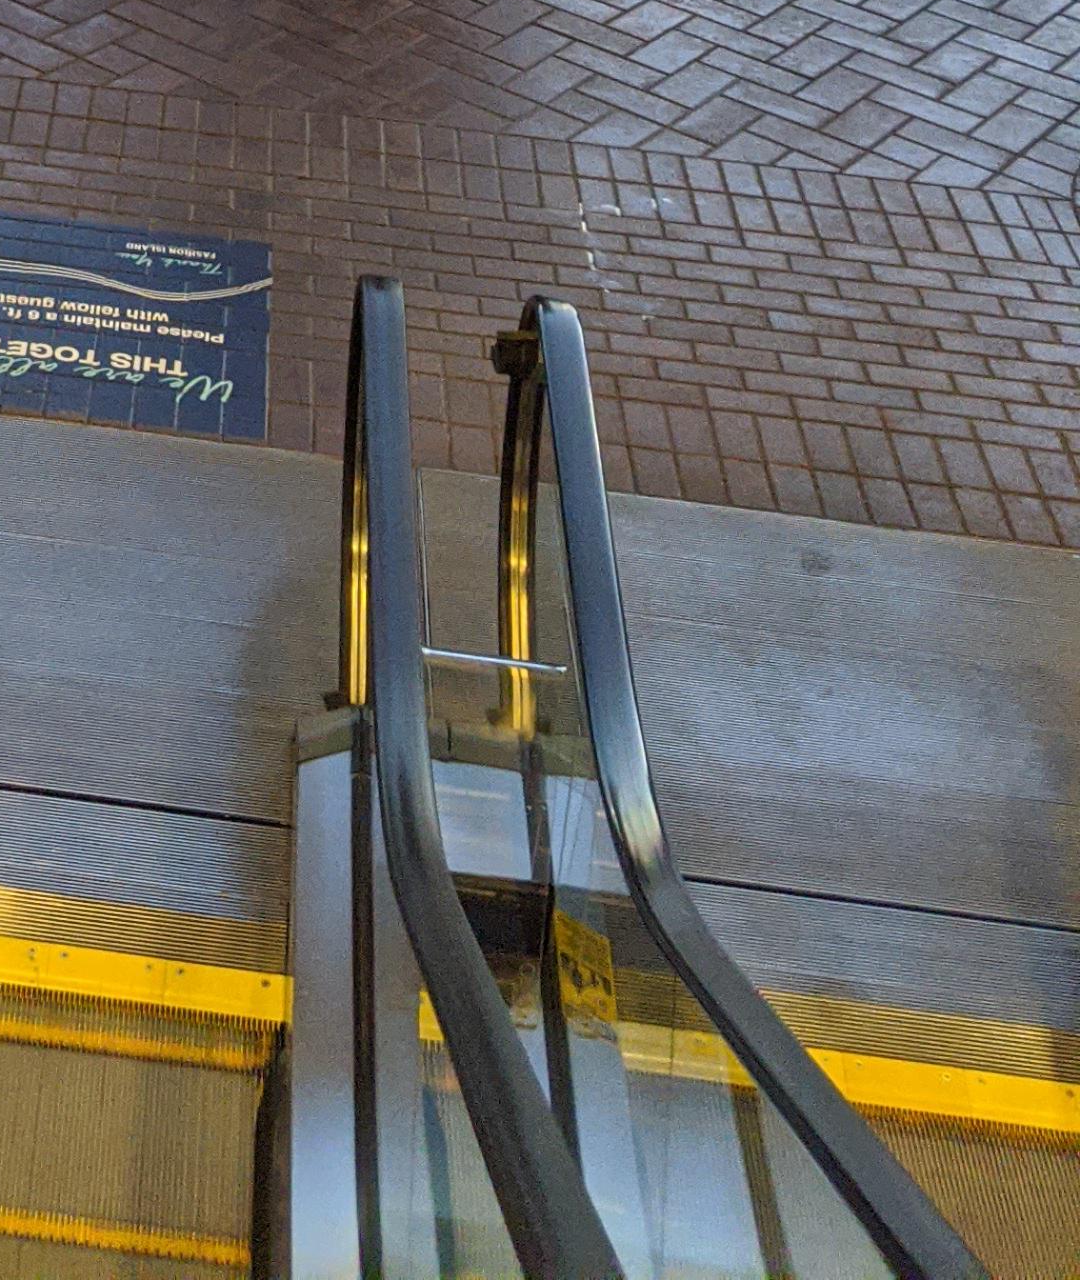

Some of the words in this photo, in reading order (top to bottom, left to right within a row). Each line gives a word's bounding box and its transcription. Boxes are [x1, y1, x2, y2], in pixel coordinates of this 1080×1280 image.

[125, 242, 166, 254] ISLAND
[168, 246, 217, 260] FASHION
[161, 256, 223, 275] Thank
[1, 305, 22, 320] ft.
[27, 308, 40, 321] 6
[45, 310, 58, 321] a
[60, 300, 120, 318] fellow
[126, 307, 169, 322] with
[63, 313, 151, 333] maintain
[157, 324, 225, 345] Please
[109, 351, 189, 377] THIS
[73, 366, 145, 384] are
[158, 374, 235, 404] We
